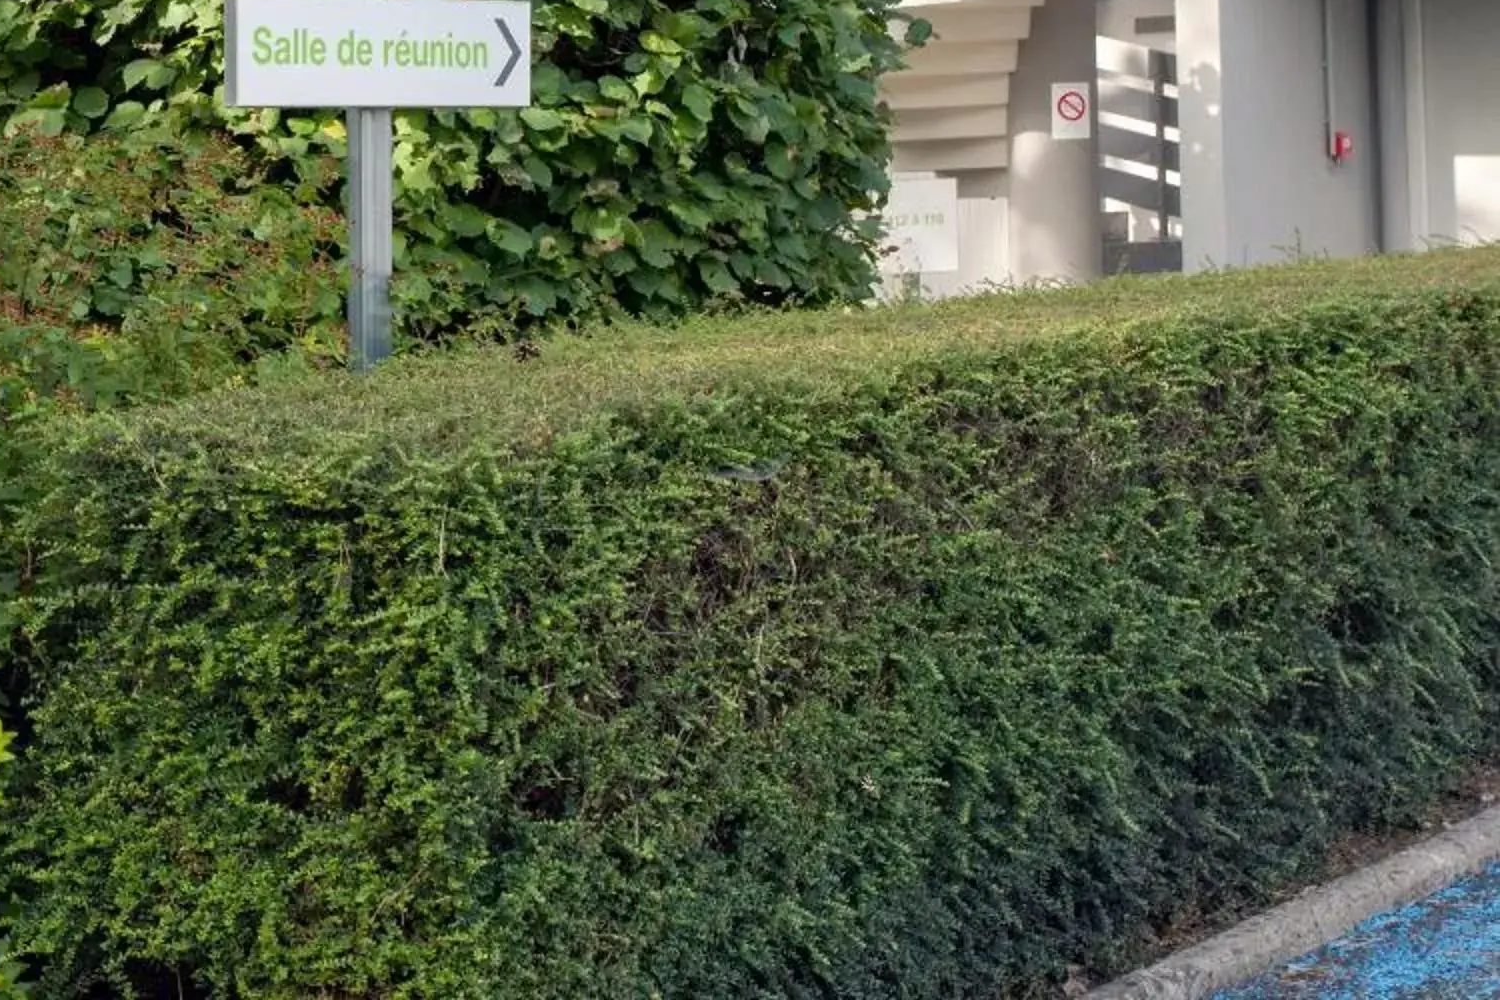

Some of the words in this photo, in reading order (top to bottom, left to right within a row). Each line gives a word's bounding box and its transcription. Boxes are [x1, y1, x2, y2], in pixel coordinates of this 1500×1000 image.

[252, 26, 326, 66] Salle
[337, 29, 373, 67] de
[383, 30, 488, 68] réunion
